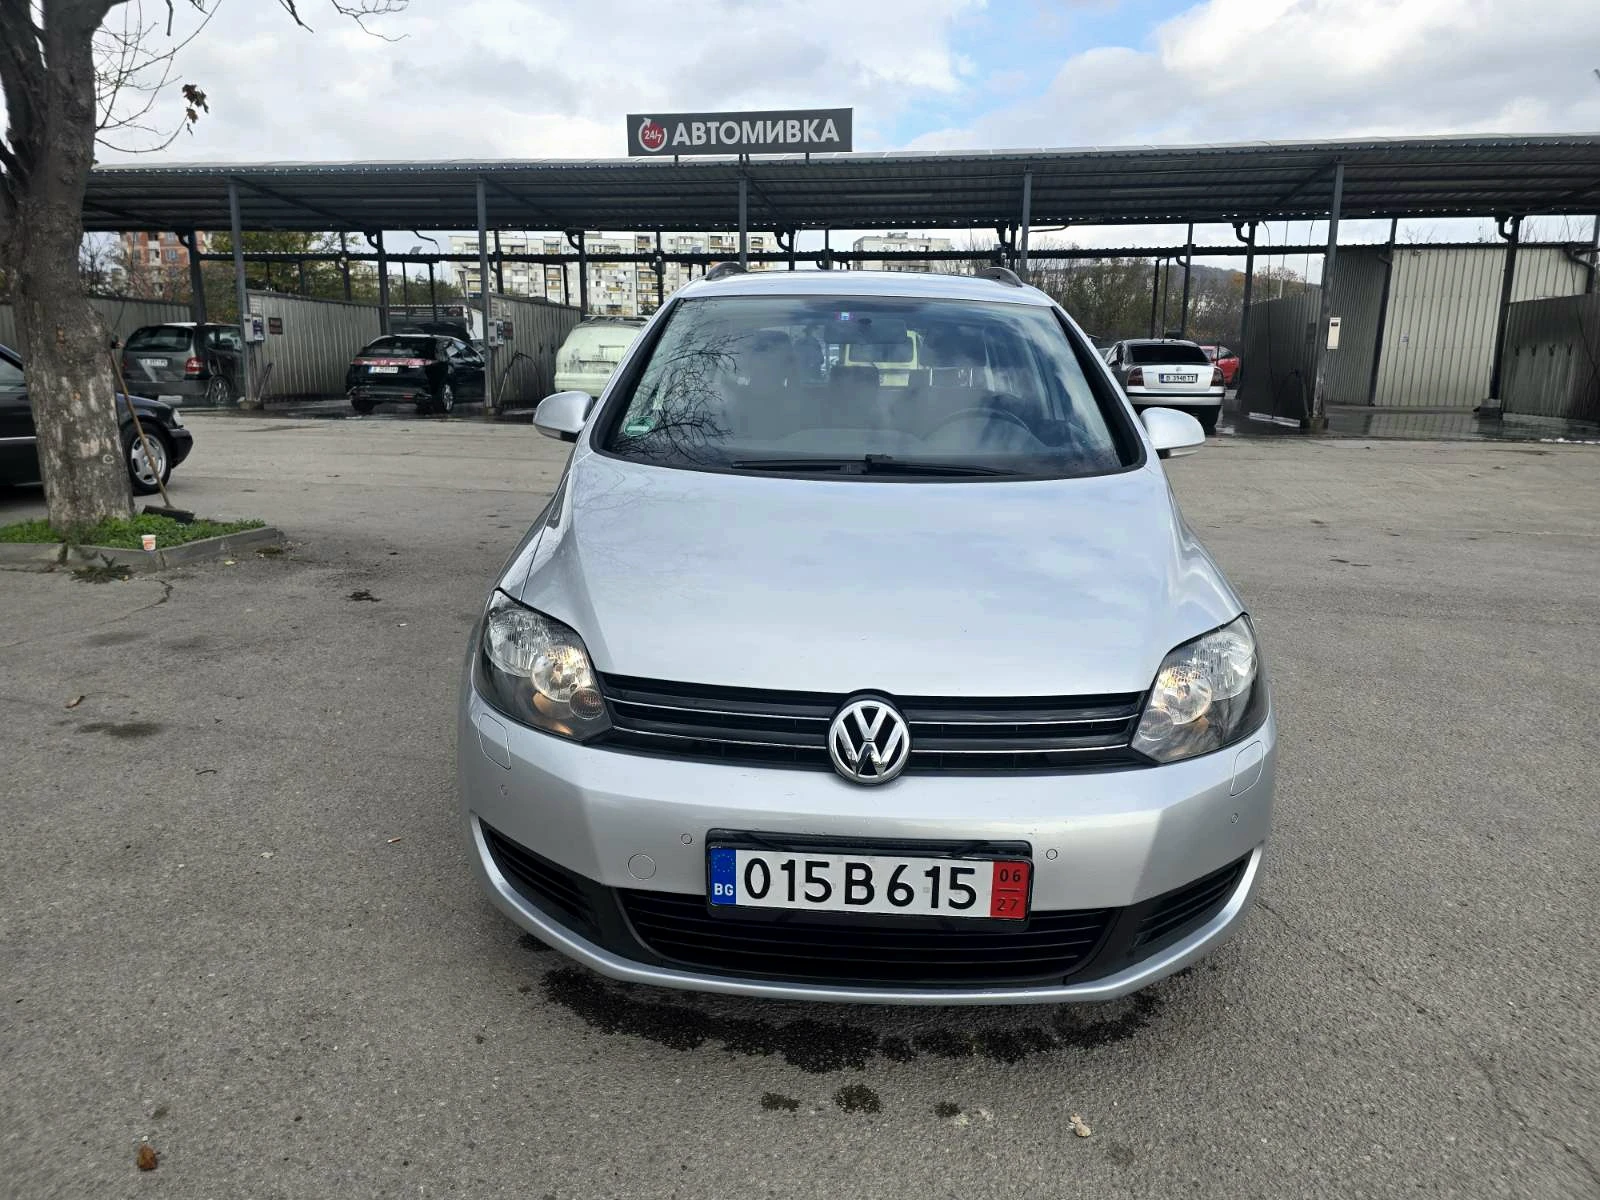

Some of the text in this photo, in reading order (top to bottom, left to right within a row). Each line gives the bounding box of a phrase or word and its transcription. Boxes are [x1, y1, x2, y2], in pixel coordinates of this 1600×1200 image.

[644, 118, 840, 146] 24/7 АВТОМИВКА
[832, 701, 907, 780] VW
[1000, 868, 1021, 882] 06
[714, 883, 734, 897] BG
[997, 898, 1018, 912] 27
